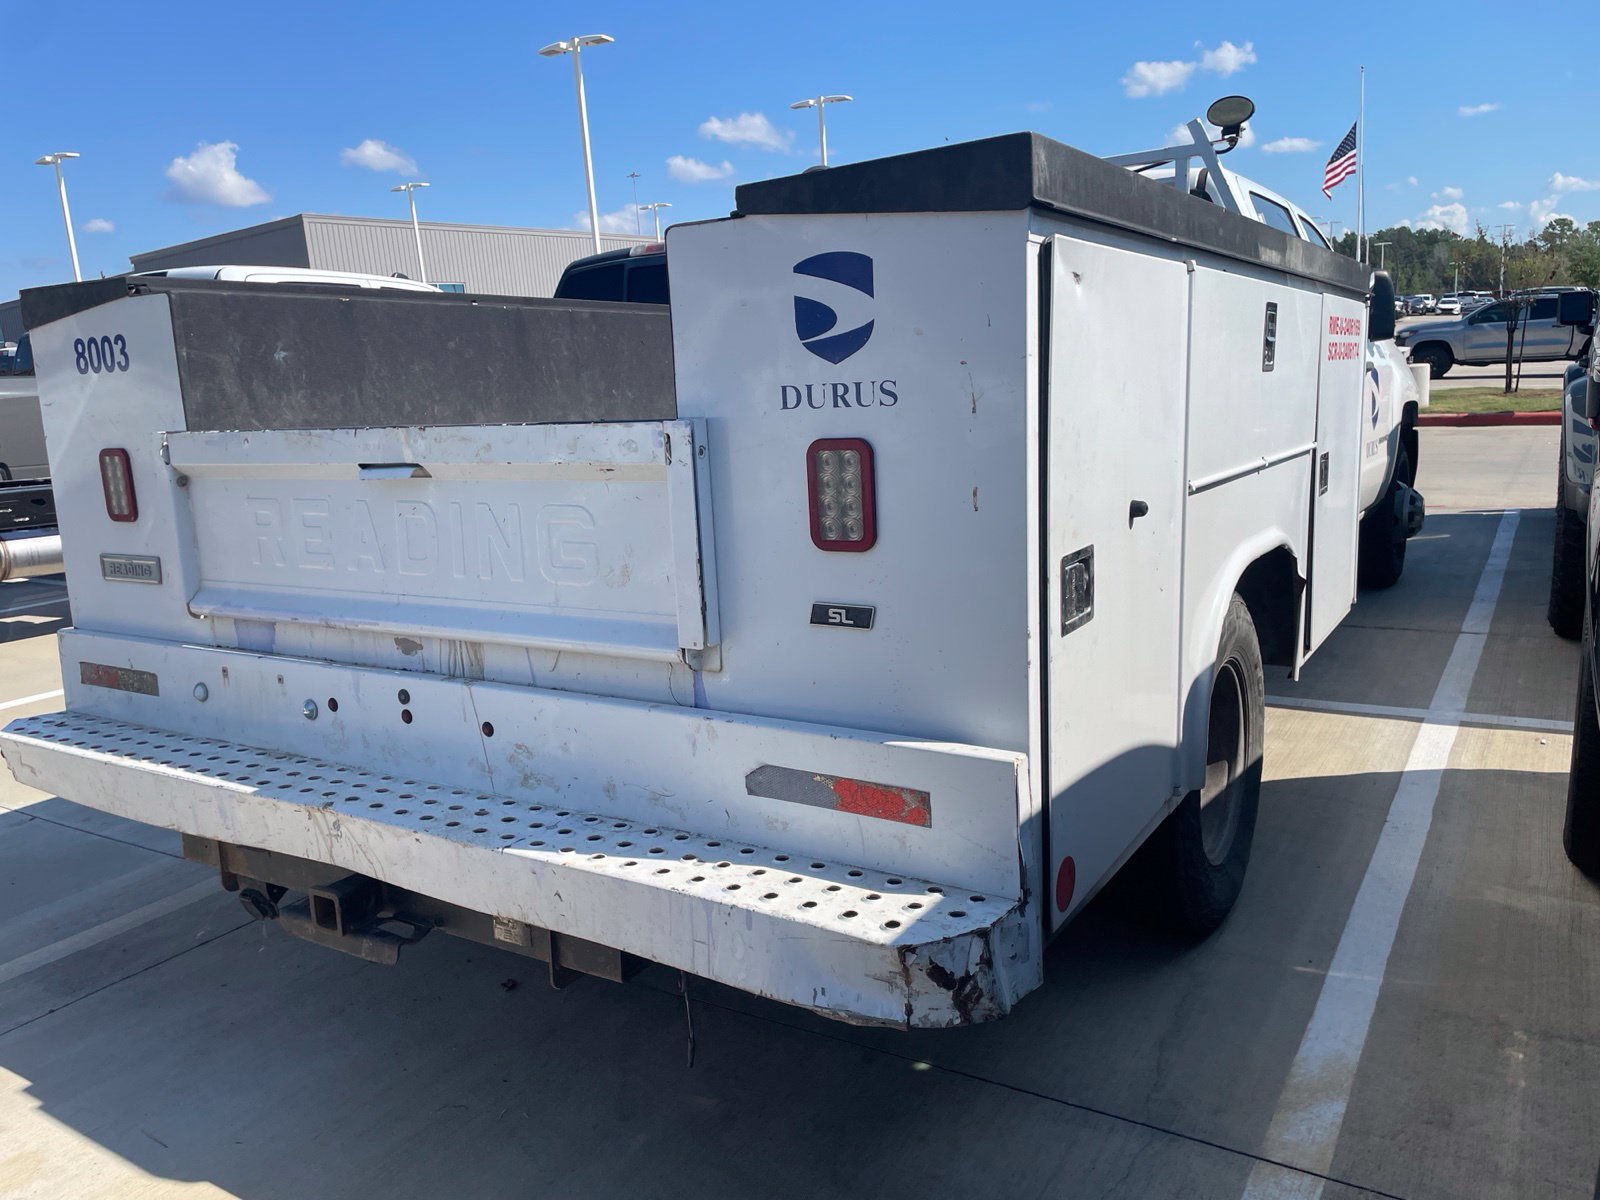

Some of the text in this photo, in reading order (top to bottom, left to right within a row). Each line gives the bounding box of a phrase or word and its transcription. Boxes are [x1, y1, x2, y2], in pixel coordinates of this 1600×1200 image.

[74, 334, 130, 375] 8003
[780, 379, 899, 411] DURUS
[245, 497, 599, 587] READING
[108, 560, 152, 577] READING
[828, 608, 854, 625] SL
